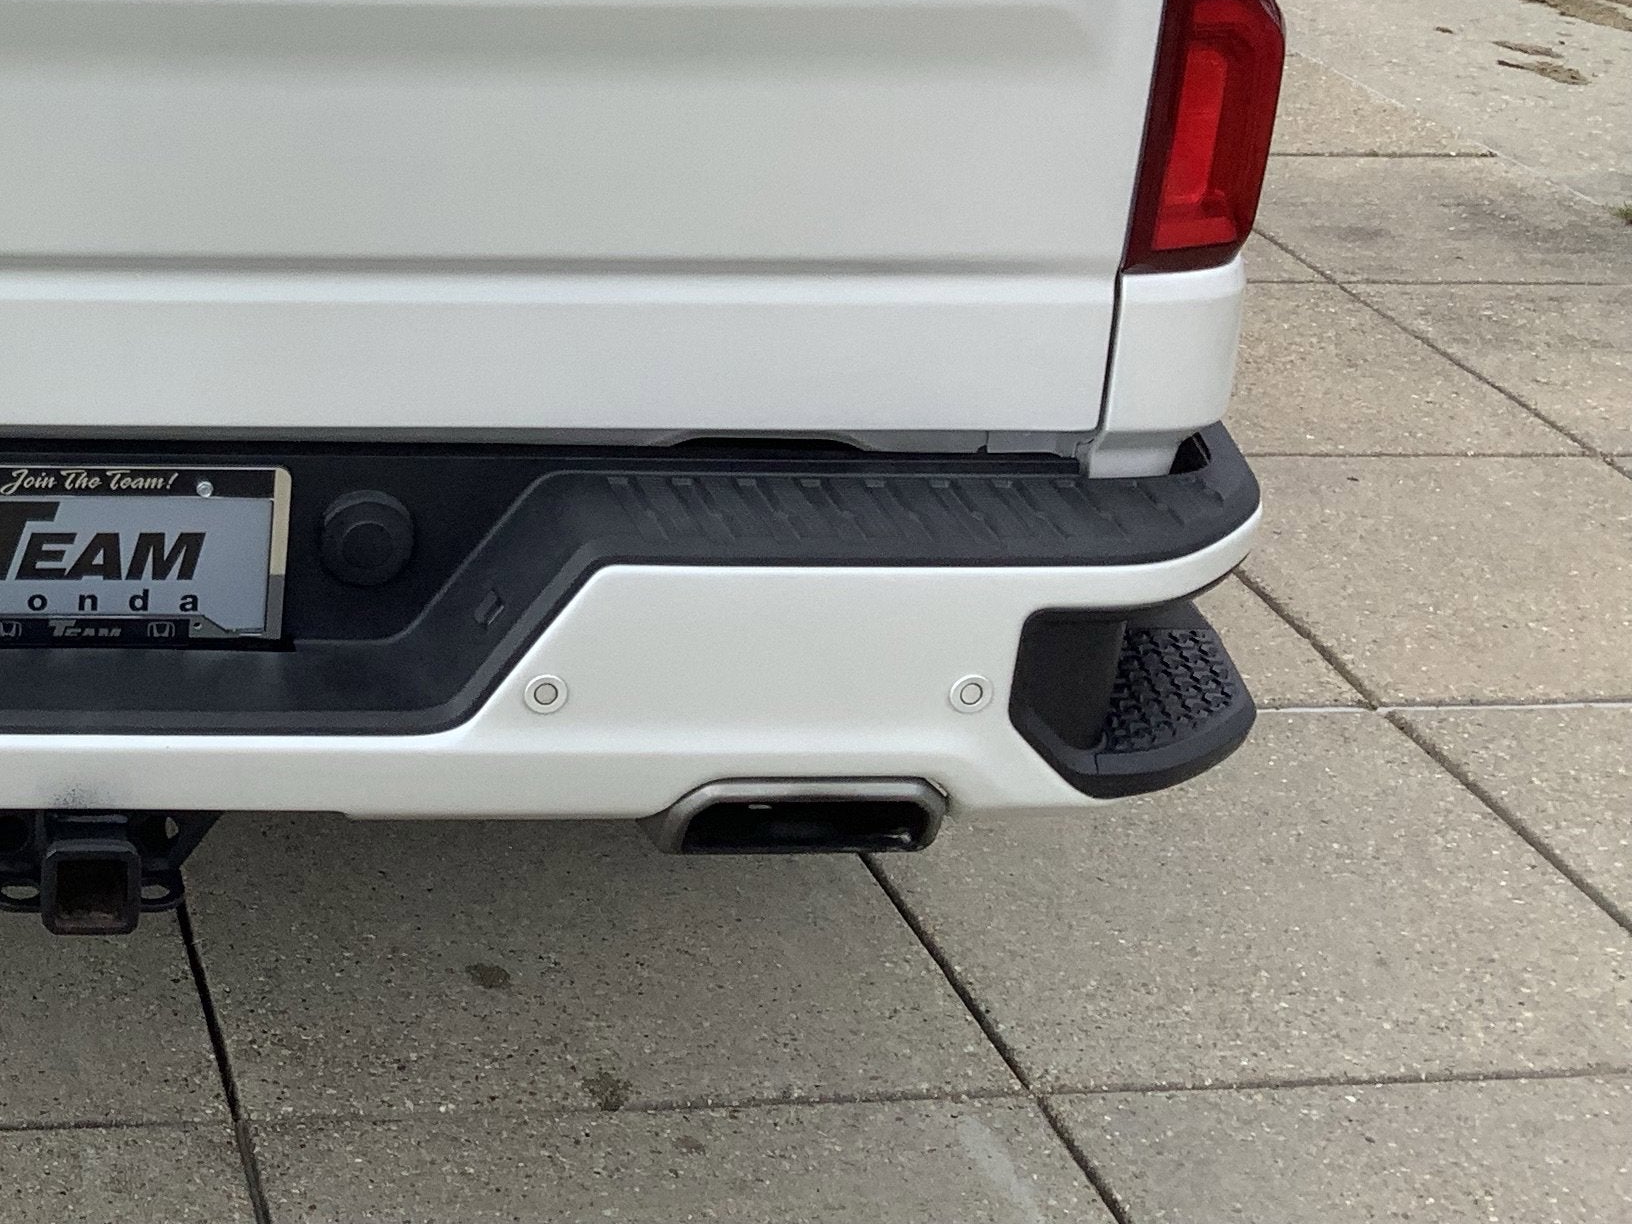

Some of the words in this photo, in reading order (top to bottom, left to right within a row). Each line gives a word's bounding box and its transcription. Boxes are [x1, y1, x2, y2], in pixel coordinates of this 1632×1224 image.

[0, 468, 58, 496] Join
[60, 469, 103, 490] The
[105, 470, 179, 491] Team!
